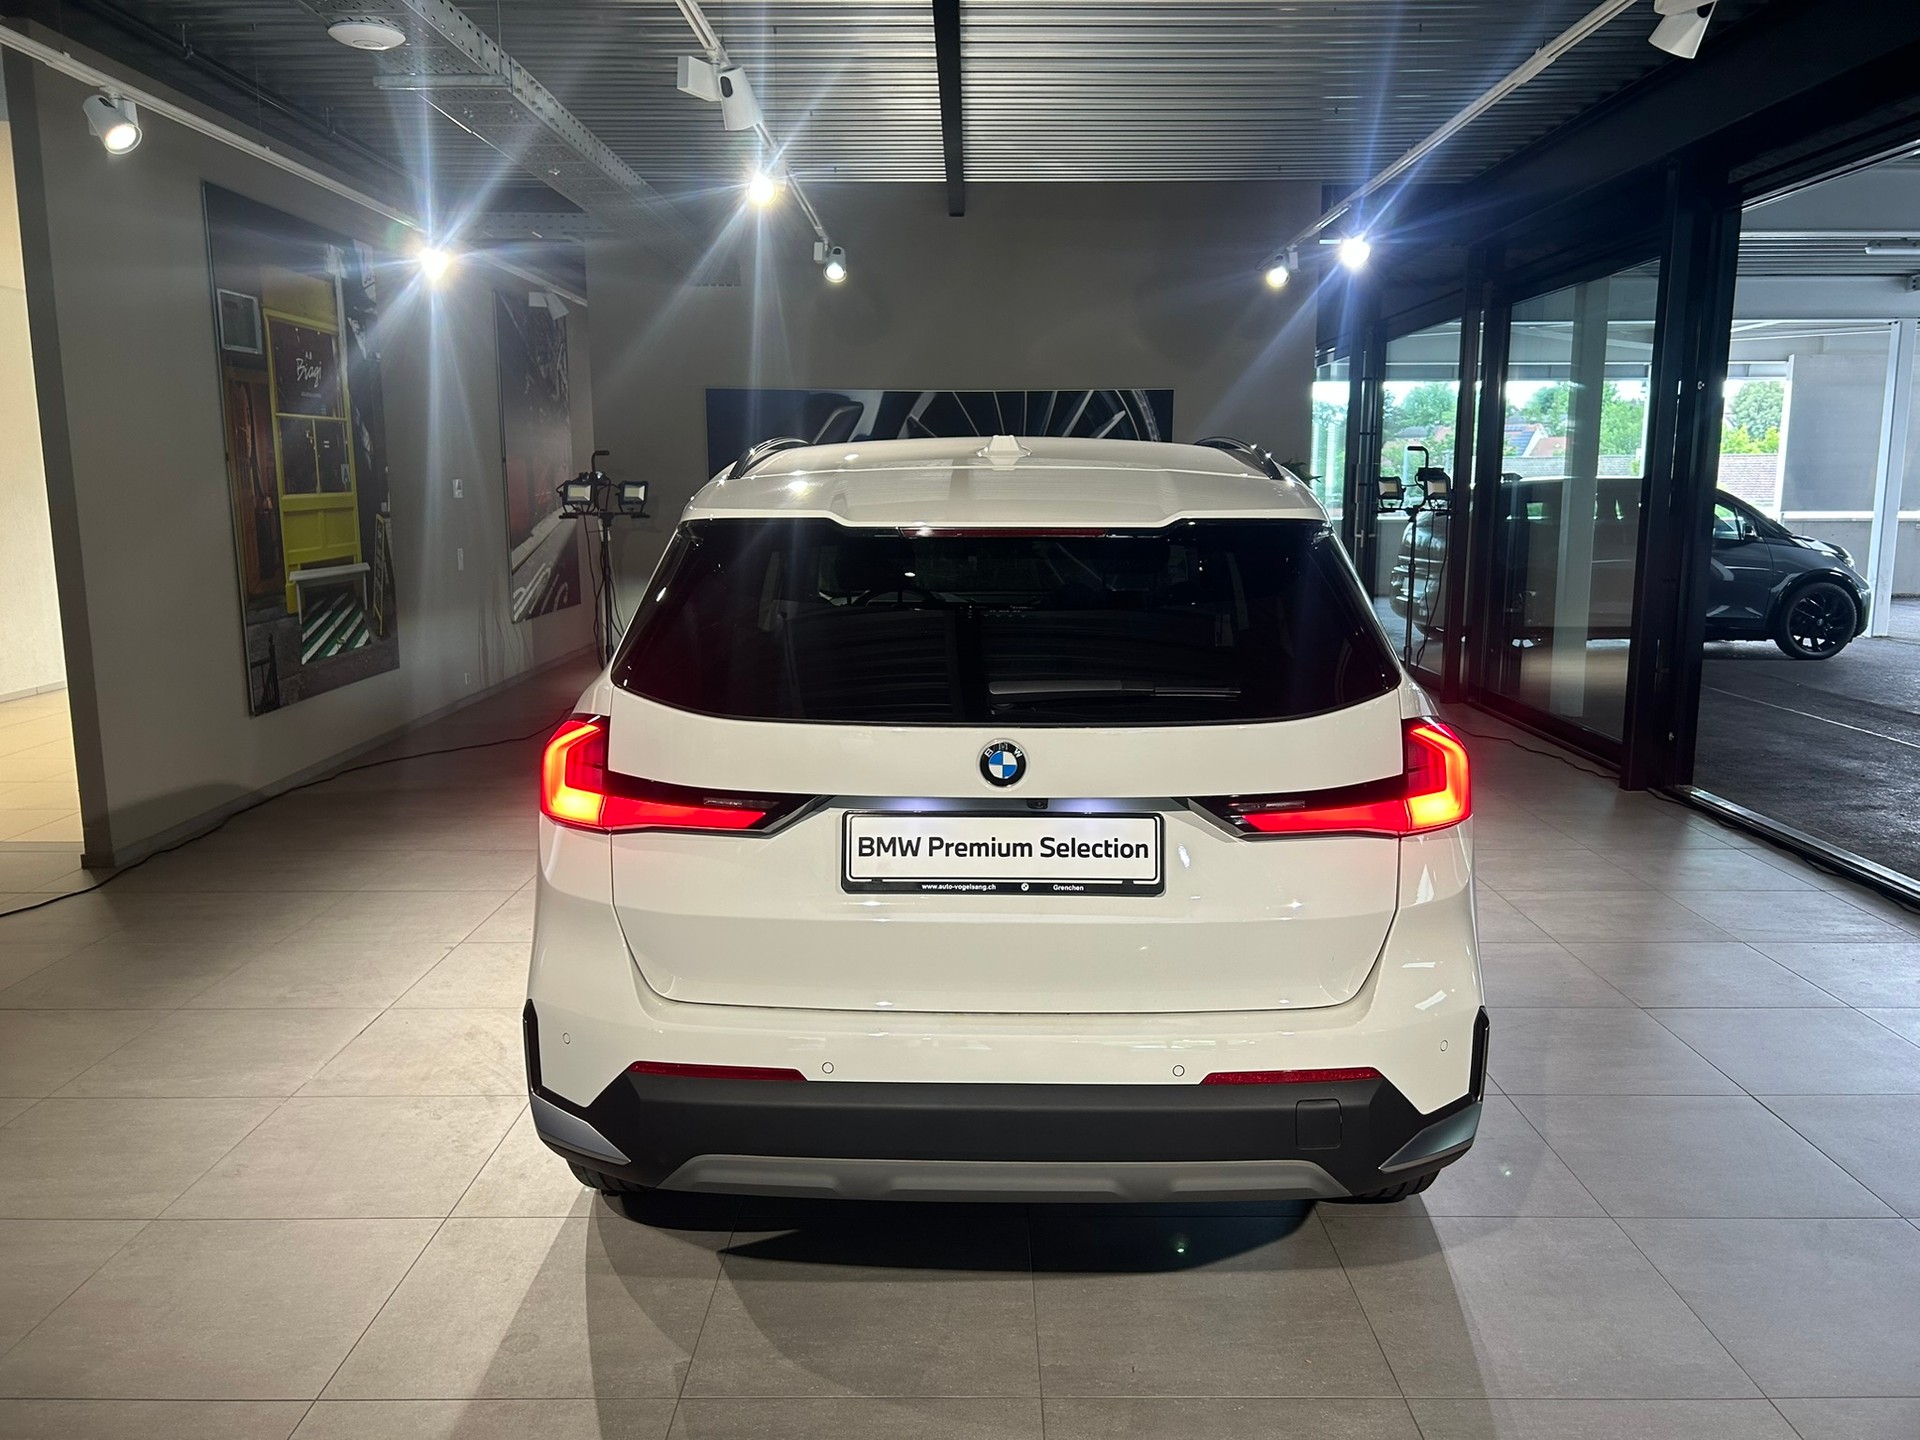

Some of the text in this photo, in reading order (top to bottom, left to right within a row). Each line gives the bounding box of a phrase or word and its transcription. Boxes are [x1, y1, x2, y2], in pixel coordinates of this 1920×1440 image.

[984, 742, 1022, 758] BMW
[858, 836, 1149, 859] BMW Premium Selection
[921, 883, 996, 891] www.auto-vogelsang.ch
